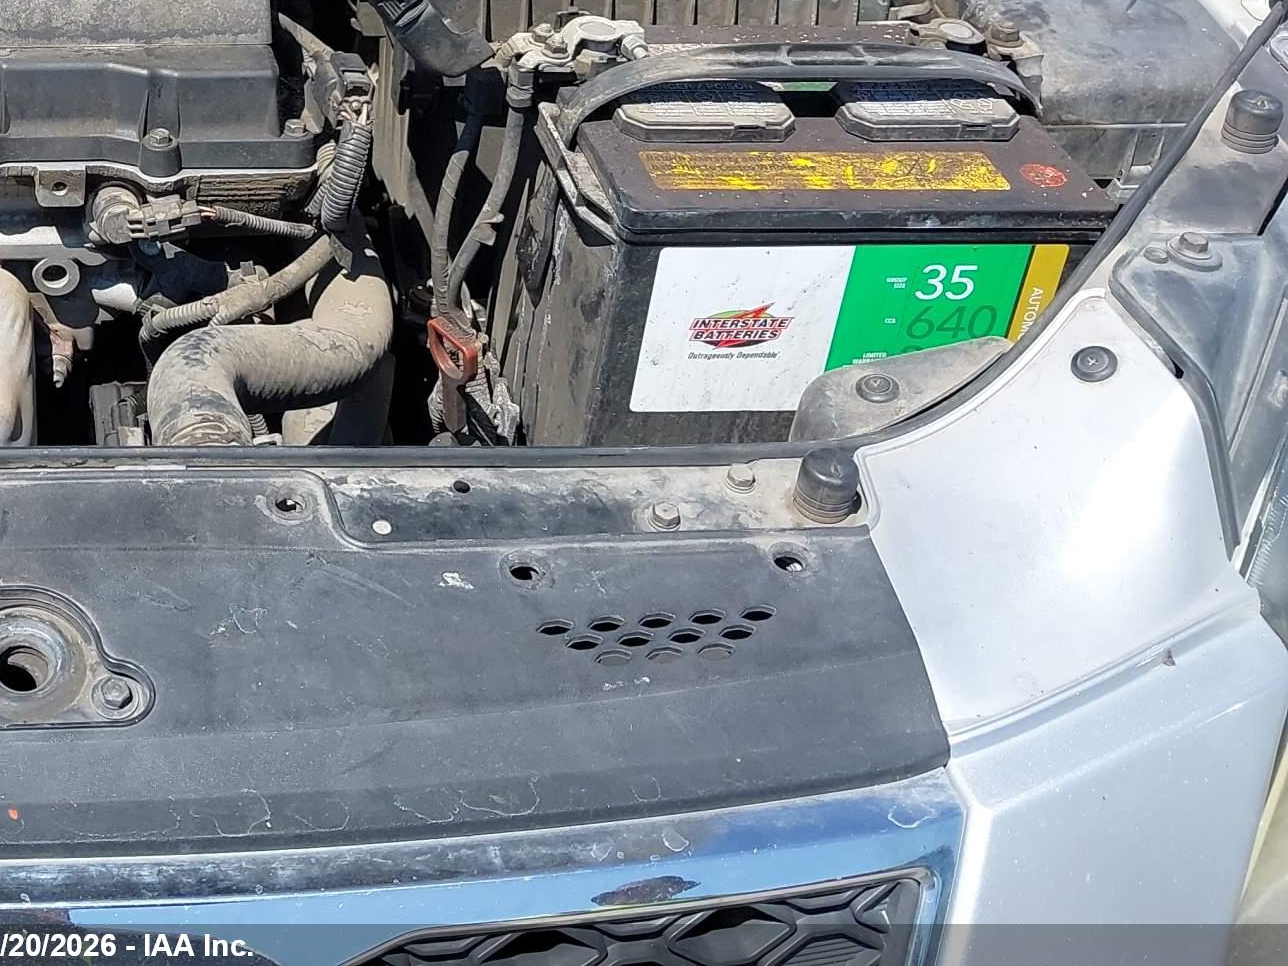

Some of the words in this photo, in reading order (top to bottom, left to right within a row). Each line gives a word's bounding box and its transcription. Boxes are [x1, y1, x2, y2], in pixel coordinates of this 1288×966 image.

[915, 264, 978, 300] 35
[692, 319, 788, 329] INTERSTATE
[906, 305, 998, 339] 640
[693, 330, 780, 340] BATTERIES
[688, 352, 735, 361] Outrageously
